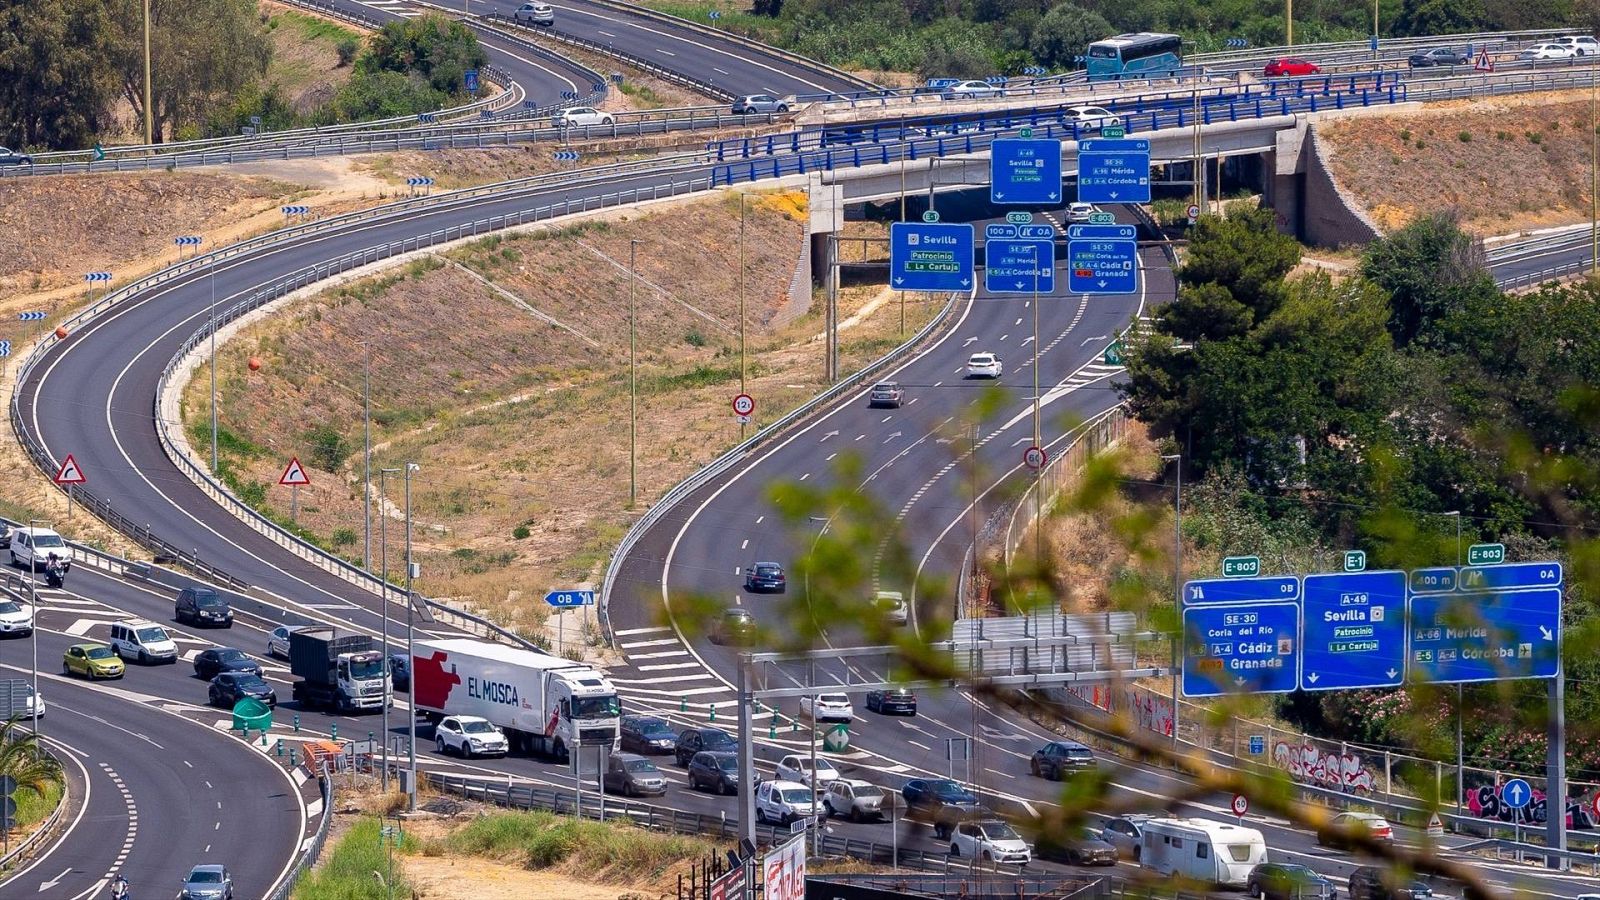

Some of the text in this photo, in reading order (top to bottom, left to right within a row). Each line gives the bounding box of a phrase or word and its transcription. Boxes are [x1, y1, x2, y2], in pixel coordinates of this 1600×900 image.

[923, 235, 957, 244] Sevilla
[912, 252, 952, 260] Patrocinio
[928, 263, 959, 272] Cartuja
[1471, 549, 1500, 560] E-803
[1347, 556, 1363, 567] E-1
[1225, 562, 1256, 572] E-803
[1342, 595, 1367, 604] A-49
[1226, 614, 1256, 624] SE-30
[1324, 610, 1366, 621] Sevilla
[1208, 626, 1273, 637] Coria del Río
[1335, 628, 1373, 636] Patrocinio
[1213, 645, 1231, 654] A-4
[1238, 642, 1273, 654] Cádiz
[1336, 643, 1346, 651] La
[1348, 642, 1378, 651] Cartuja
[1415, 651, 1432, 660] E-5
[1439, 650, 1456, 658] A-4
[1230, 658, 1283, 669] Granada
[468, 677, 481, 699] EL
[483, 679, 519, 707] MOSCA
[1236, 800, 1246, 808] 60
